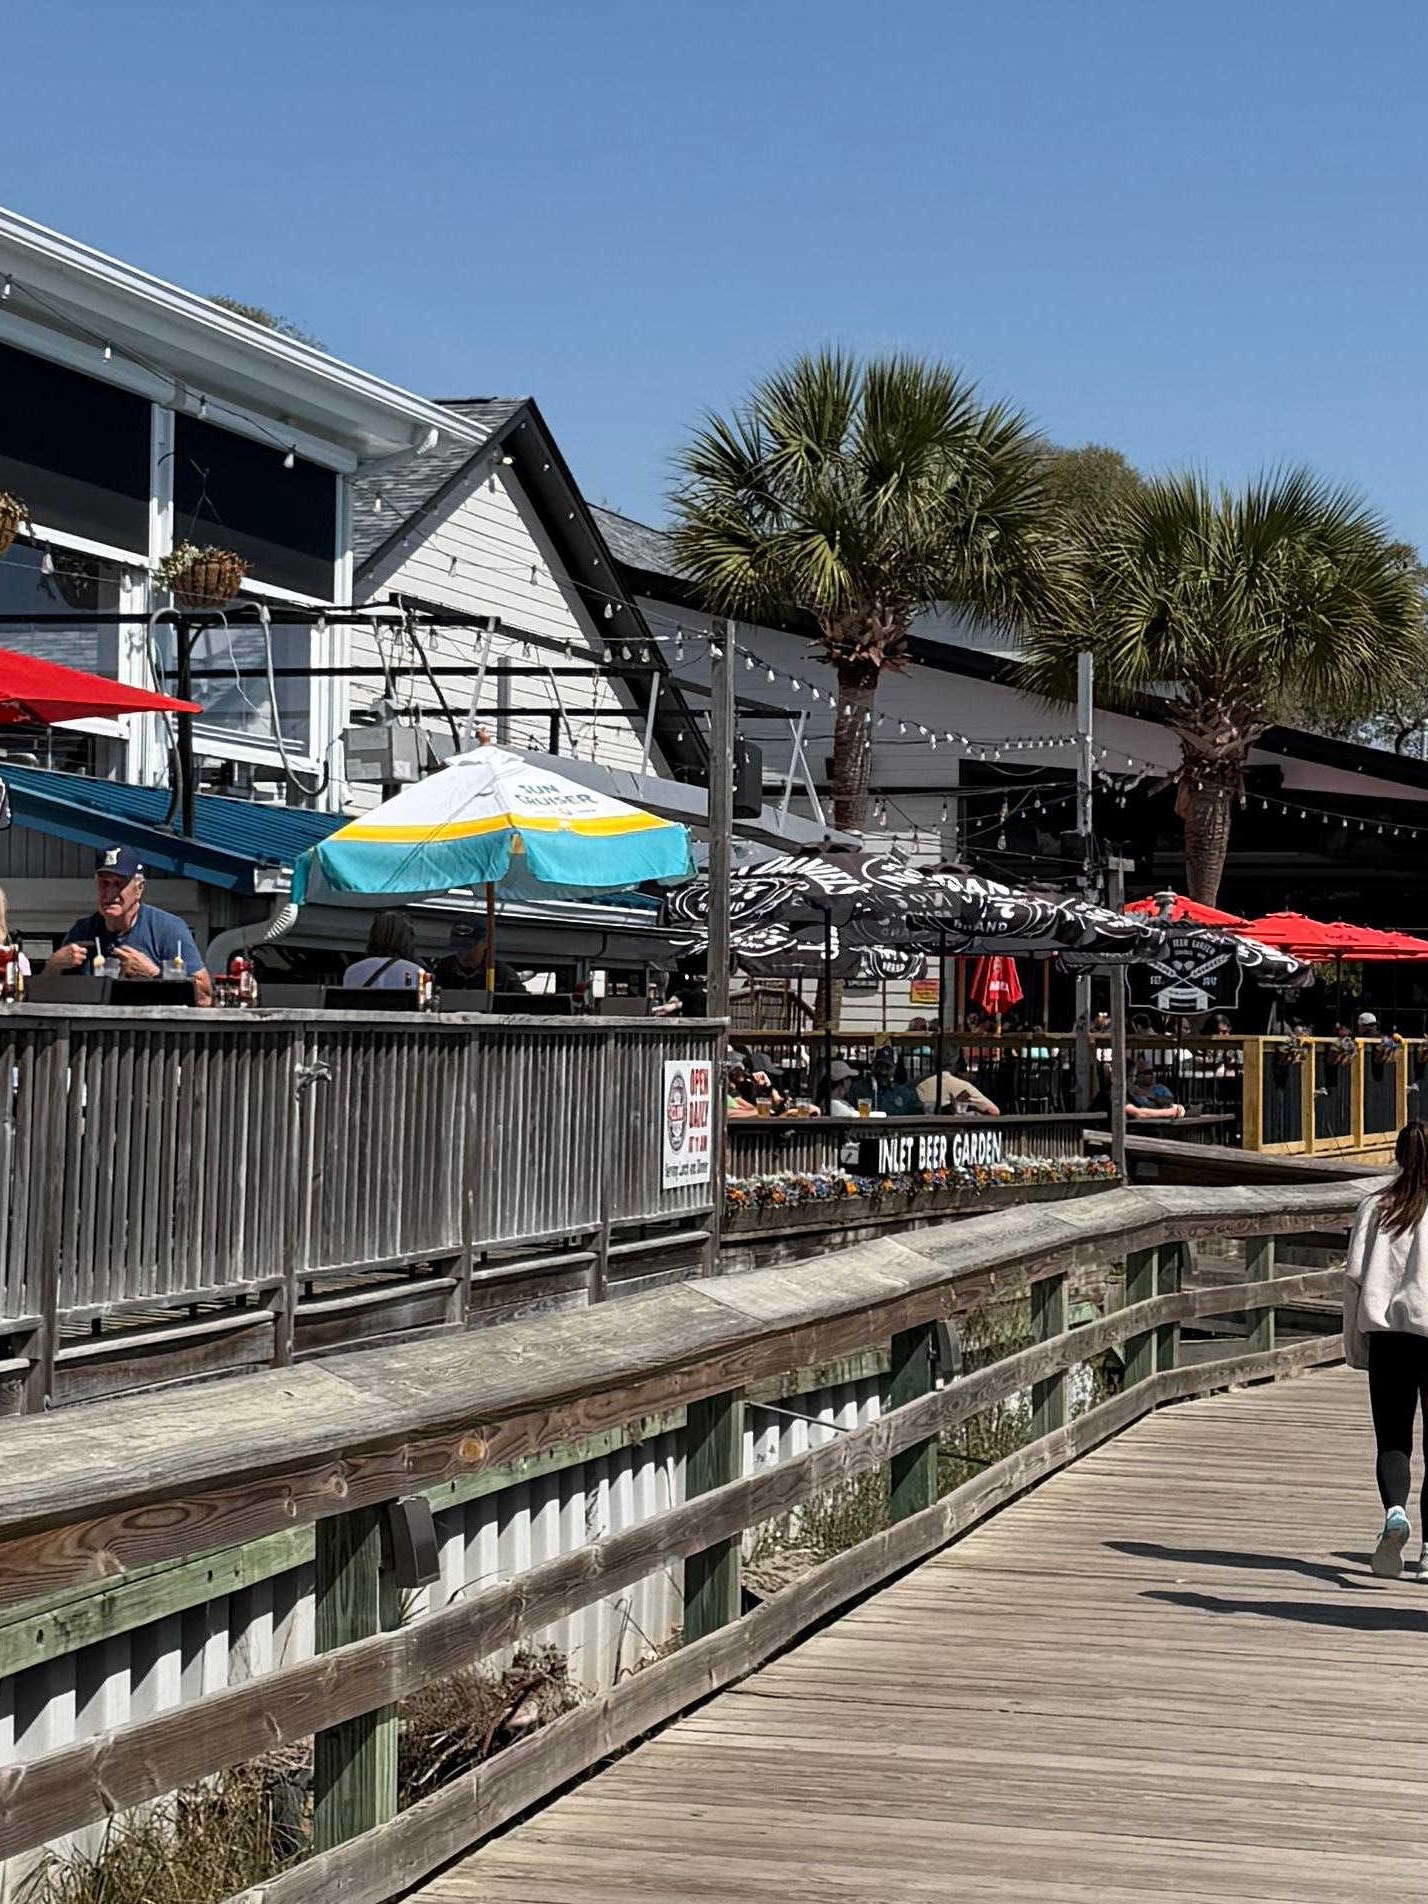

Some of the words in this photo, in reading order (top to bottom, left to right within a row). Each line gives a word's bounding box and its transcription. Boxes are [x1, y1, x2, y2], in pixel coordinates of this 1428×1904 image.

[690, 1068, 709, 1096] OPEN
[879, 1137, 914, 1173] INLET
[918, 1135, 947, 1170] BEER
[953, 1131, 1002, 1167] GARDEN
